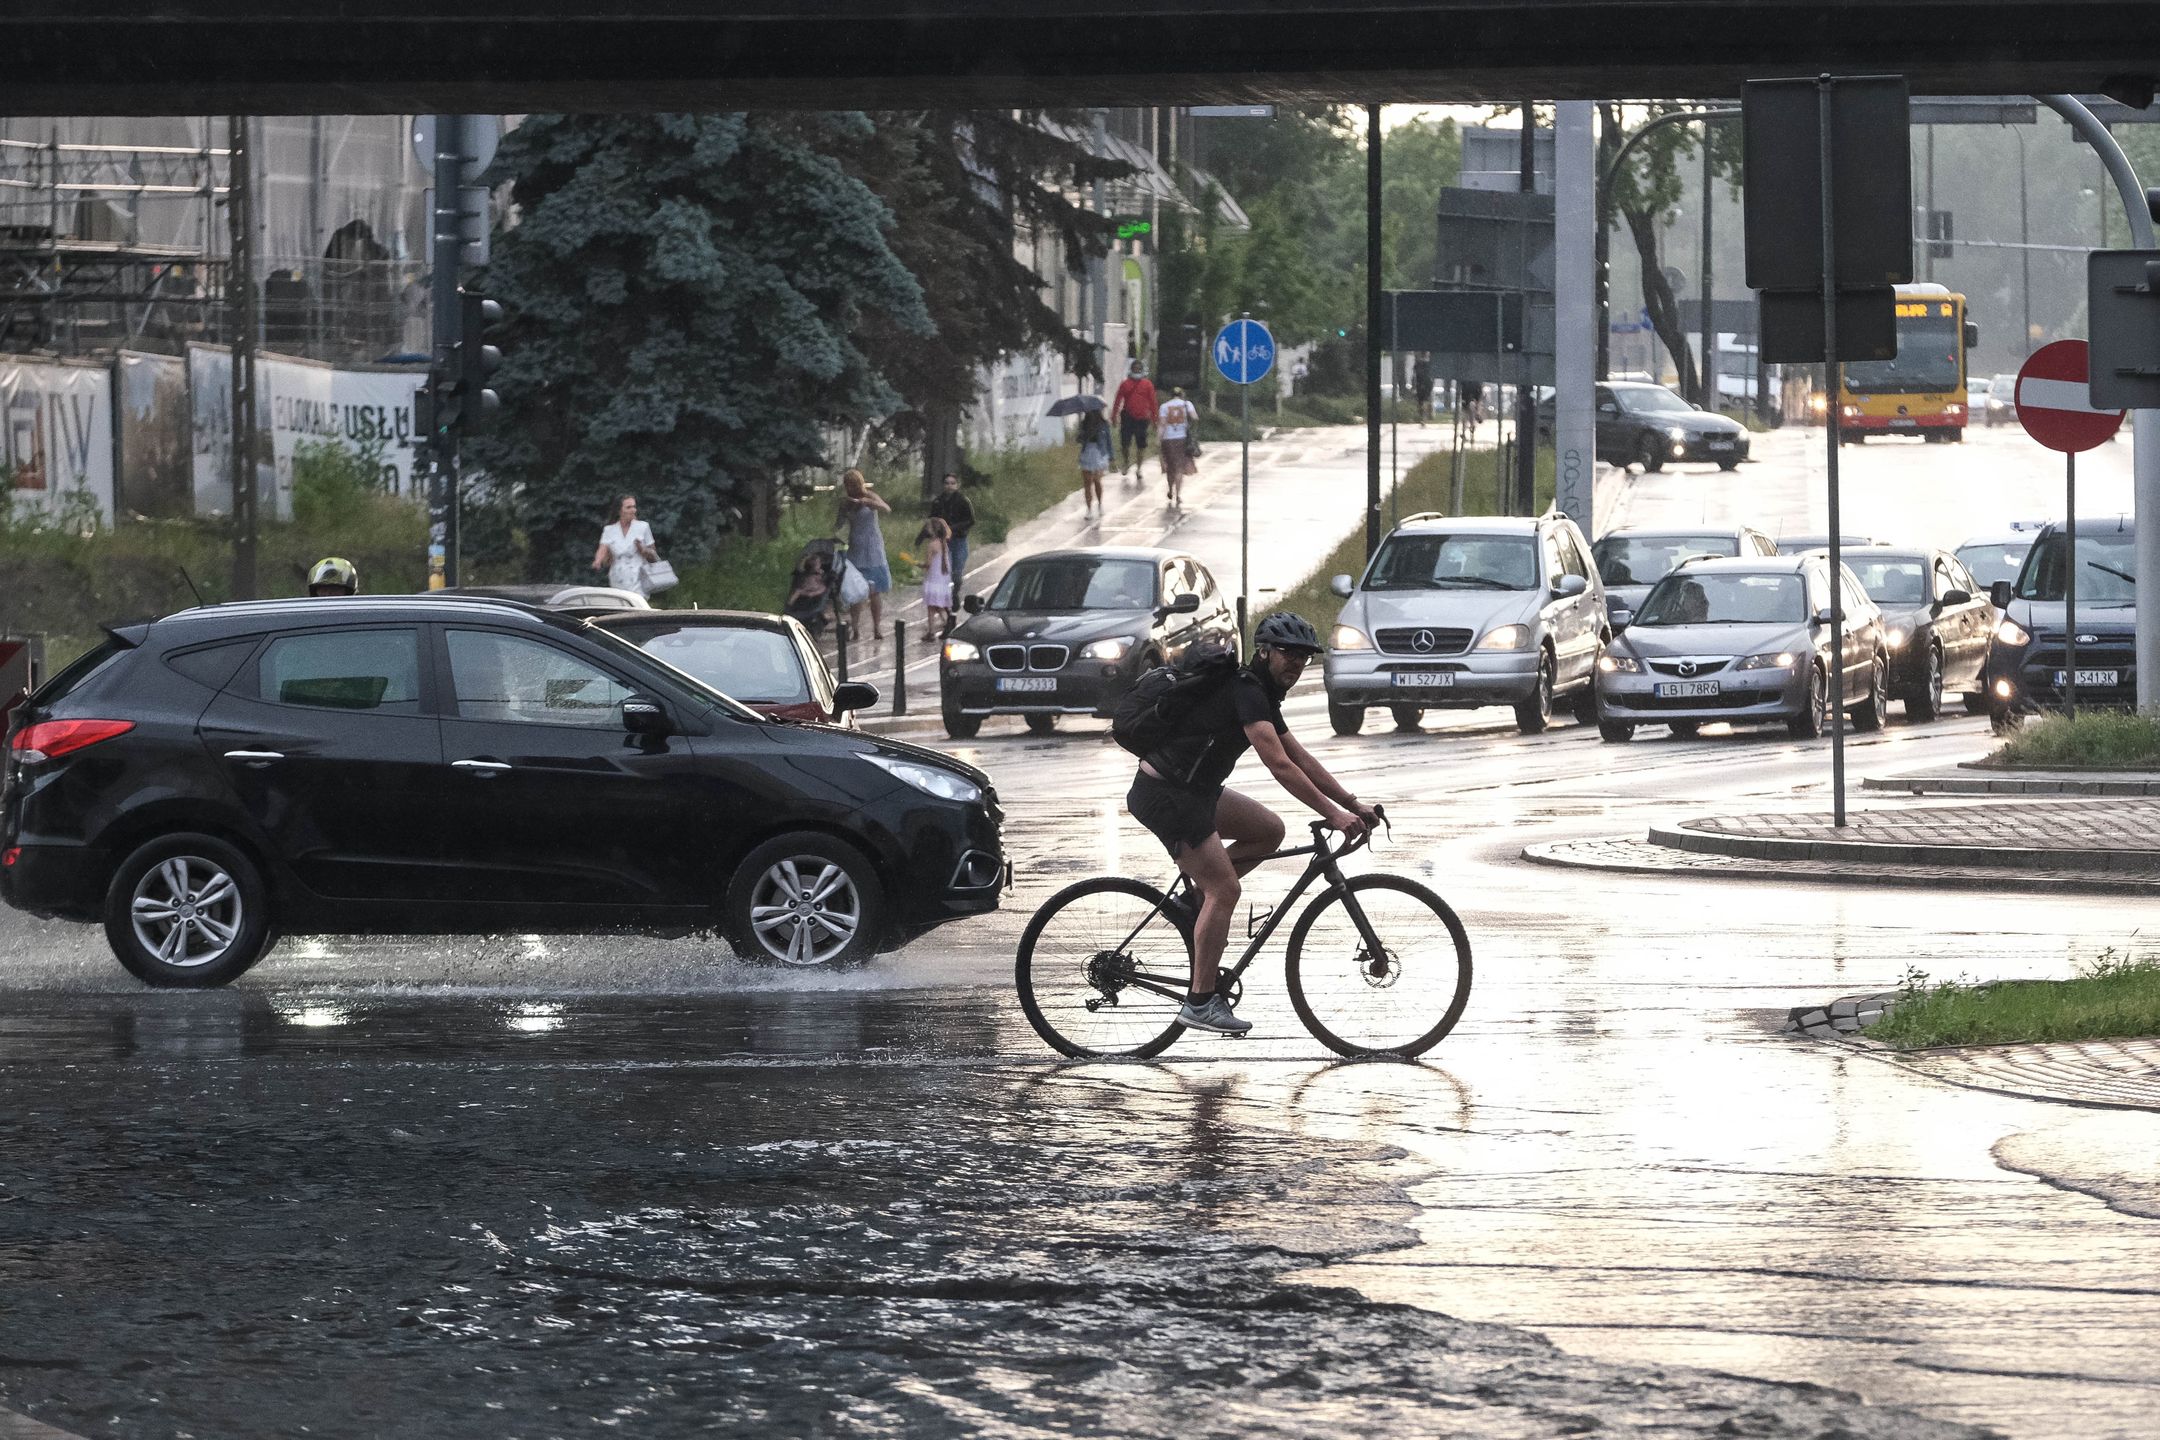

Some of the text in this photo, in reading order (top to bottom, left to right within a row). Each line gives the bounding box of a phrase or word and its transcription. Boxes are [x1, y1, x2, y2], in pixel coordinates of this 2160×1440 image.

[1417, 674, 1451, 685] 527JX
[2080, 671, 2114, 683] 5413K
[1689, 682, 1718, 695] 78R6
